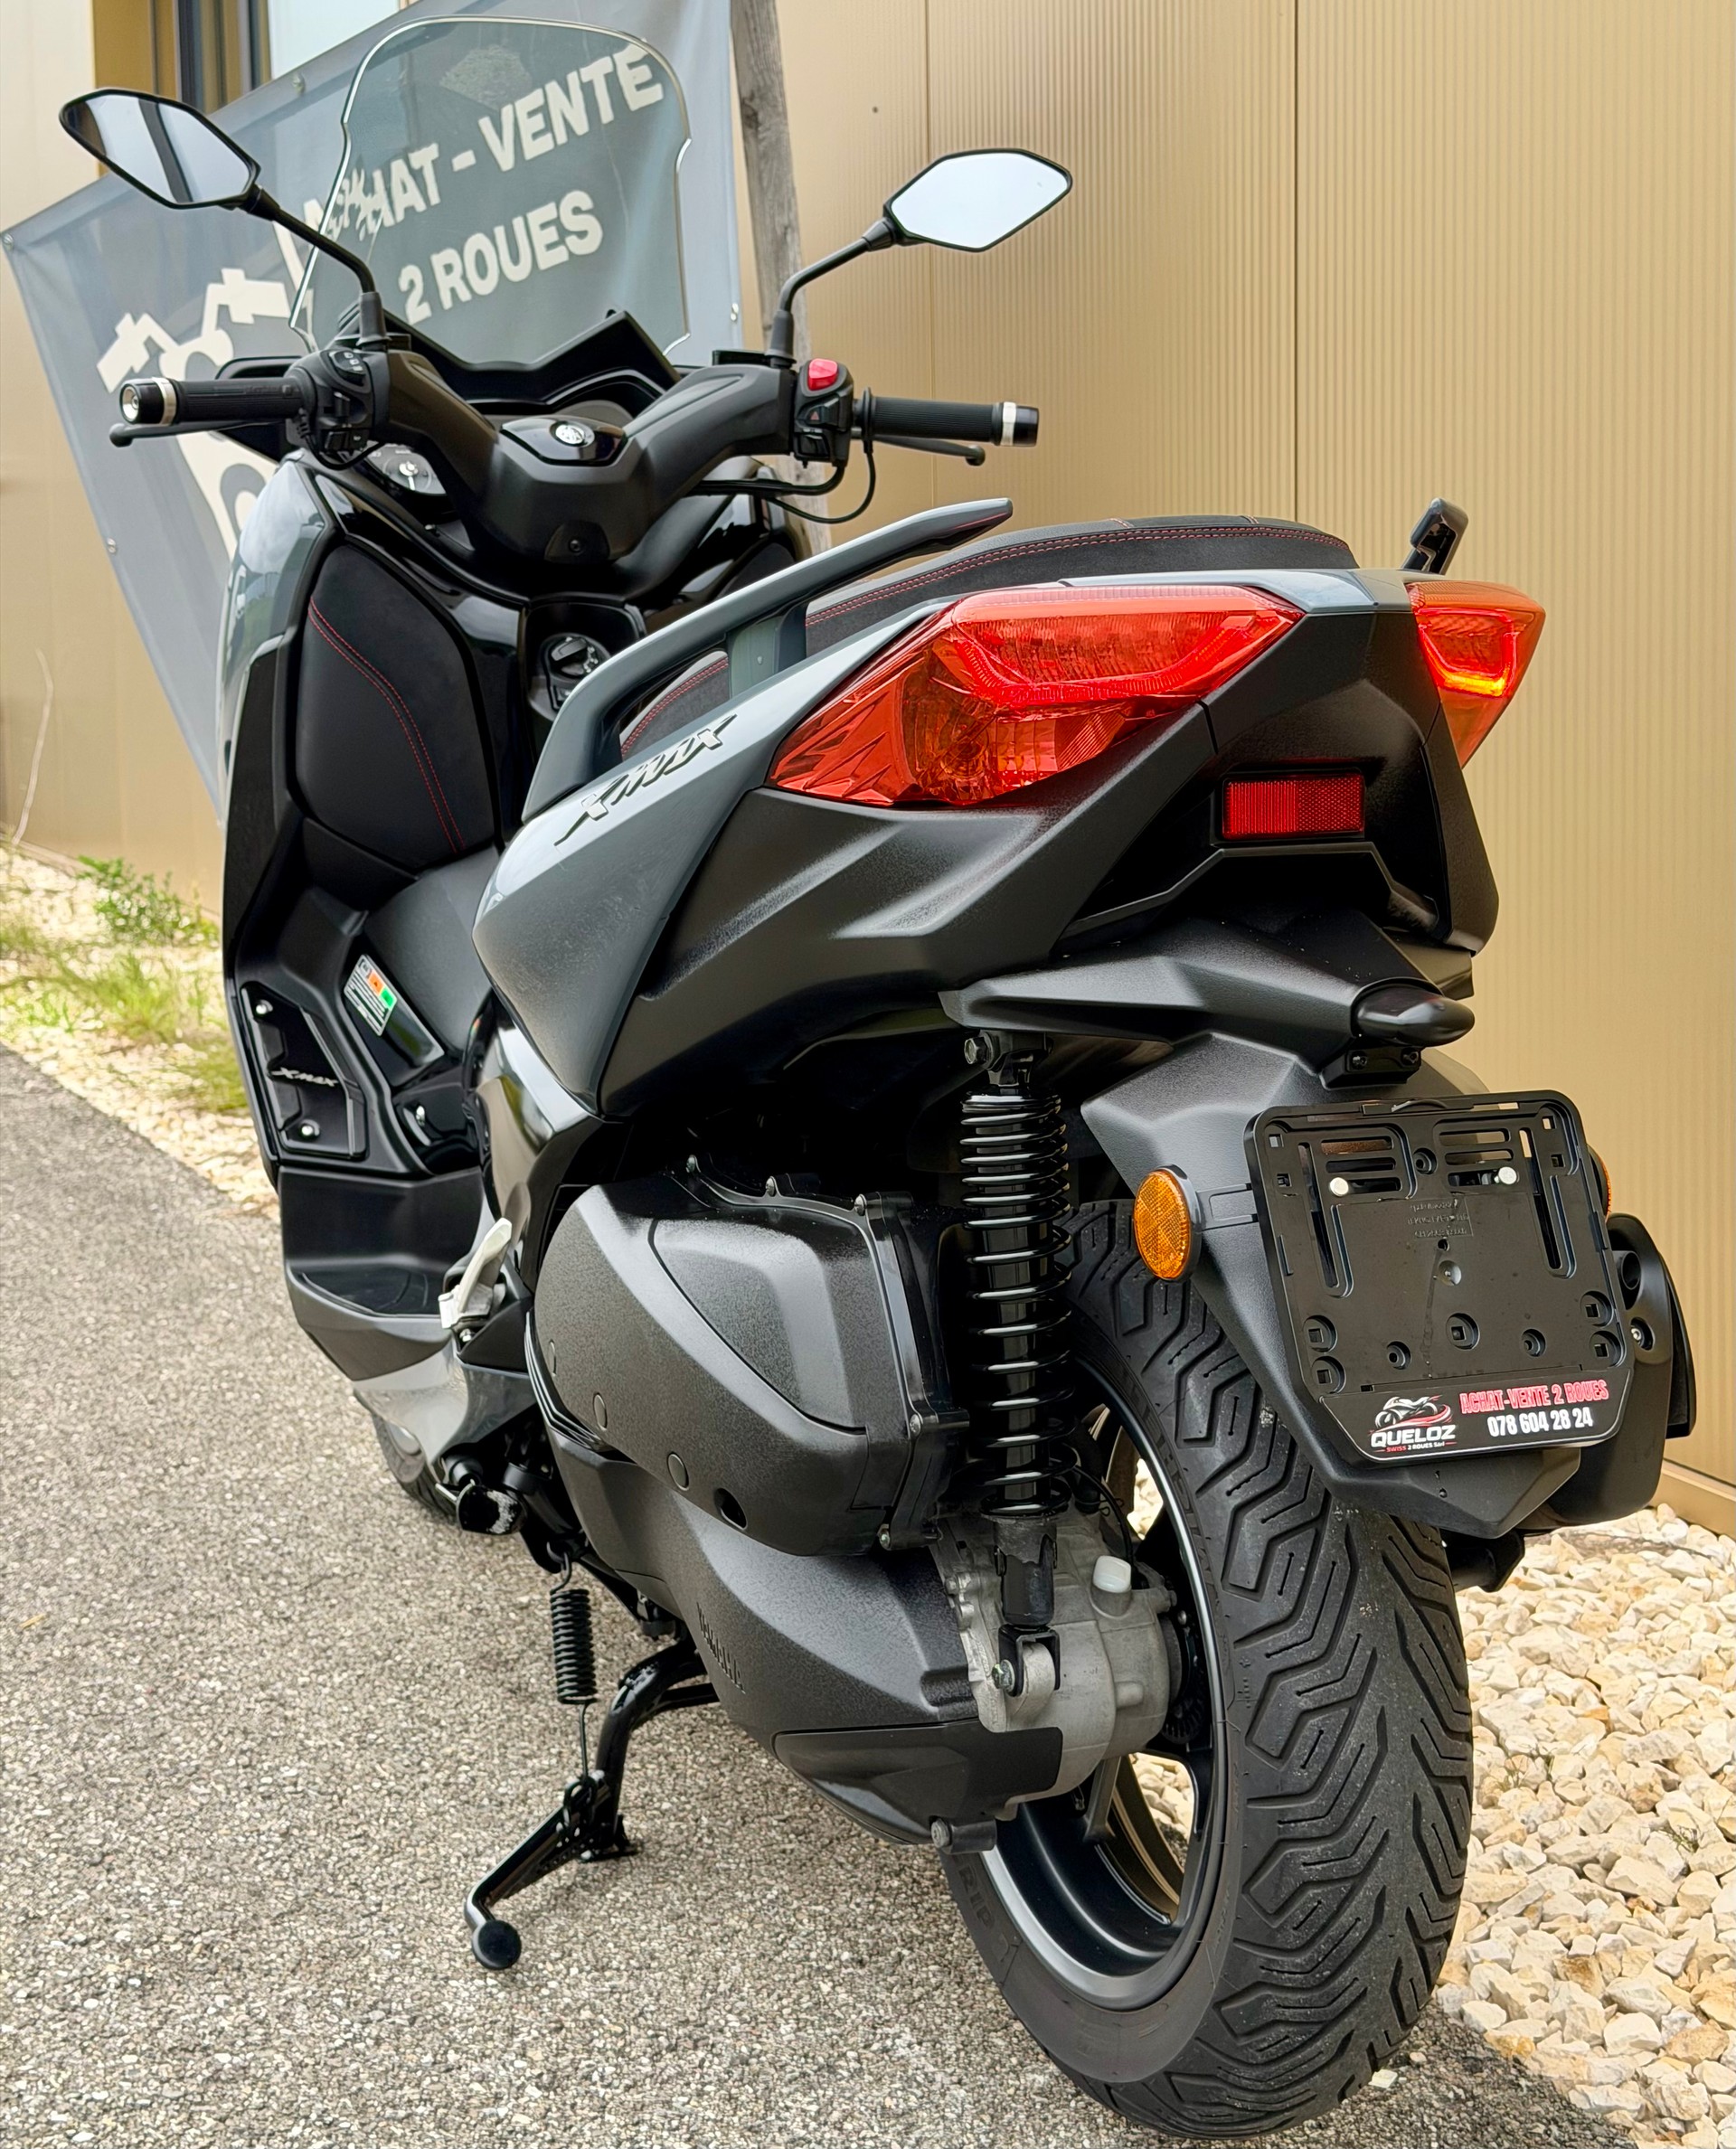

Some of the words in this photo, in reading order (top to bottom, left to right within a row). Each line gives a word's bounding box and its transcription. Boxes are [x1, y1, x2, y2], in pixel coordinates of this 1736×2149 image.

[478, 38, 664, 172] VENTE
[399, 265, 432, 325] 2
[430, 190, 603, 309] ROUES
[1459, 1385, 1551, 1414] ACHAT-VENTE
[1552, 1384, 1564, 1405] 2
[1564, 1380, 1609, 1402] ROUES
[1371, 1424, 1456, 1447] QUELOZ
[1487, 1411, 1517, 1437] 078
[1519, 1410, 1549, 1433] 604
[1550, 1408, 1571, 1430] 28
[1574, 1407, 1594, 1428] 24
